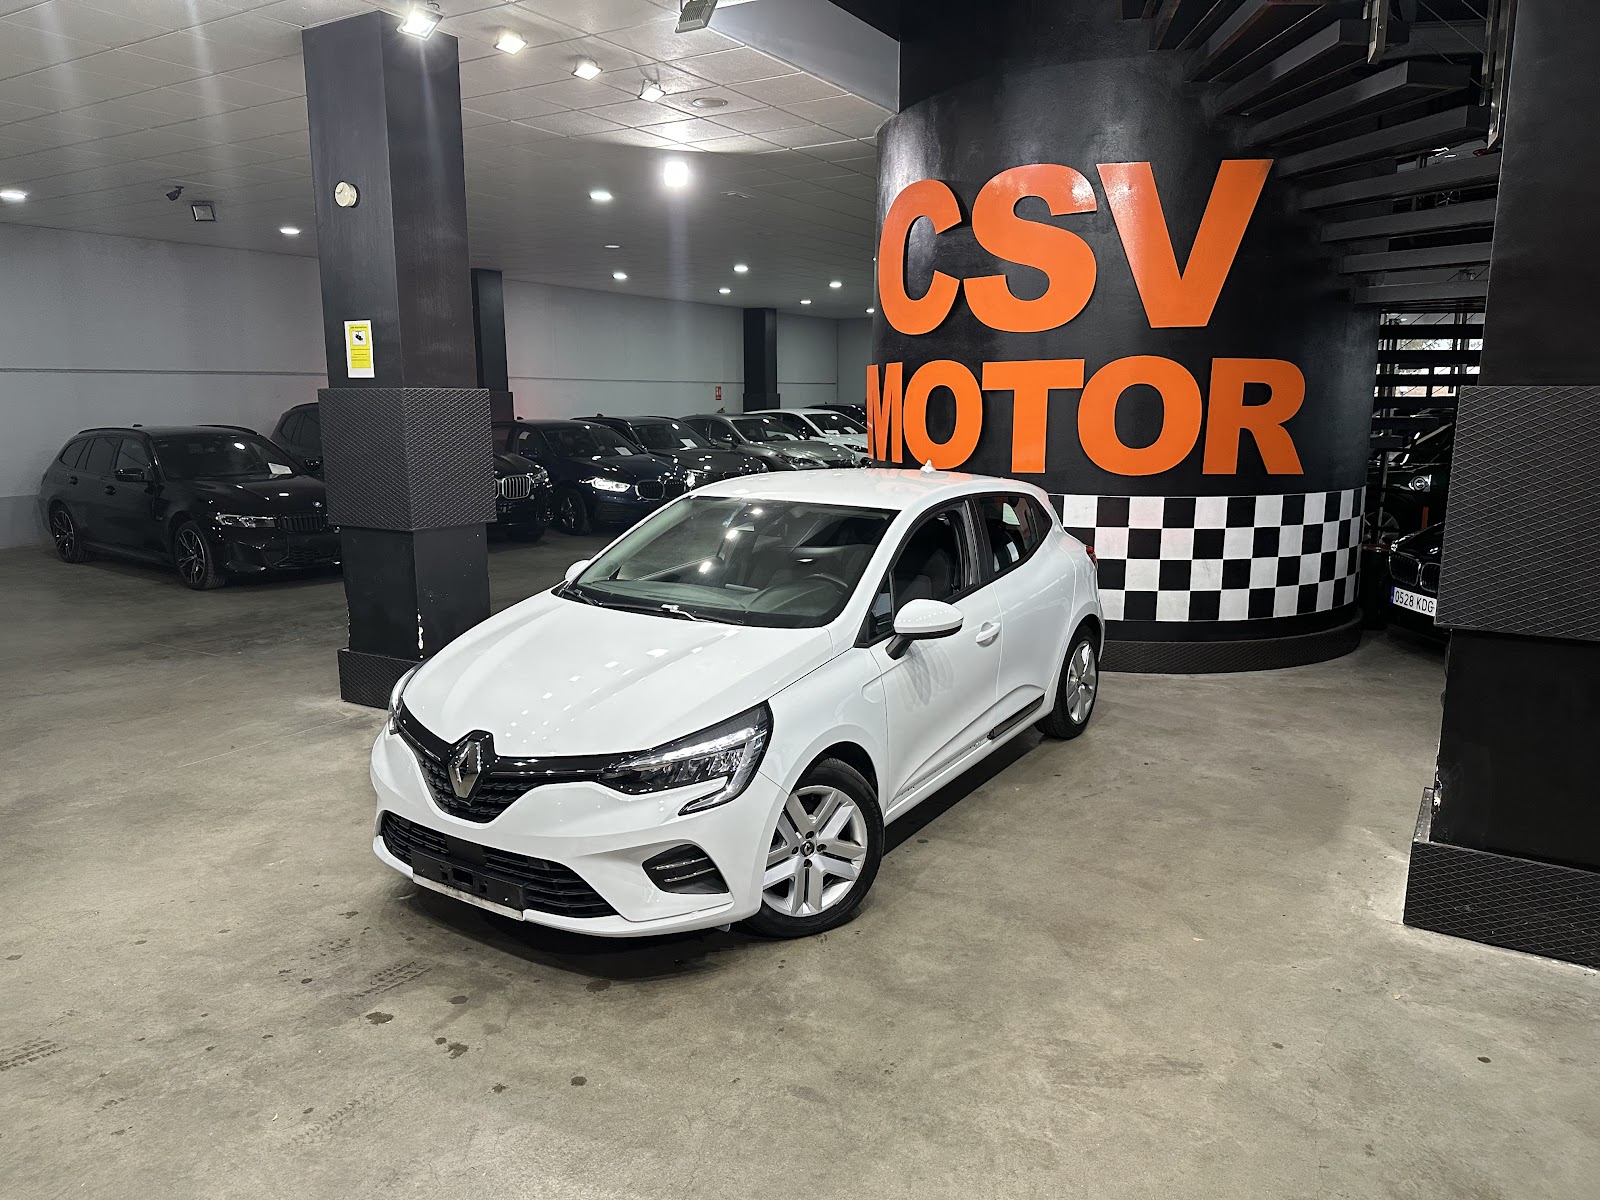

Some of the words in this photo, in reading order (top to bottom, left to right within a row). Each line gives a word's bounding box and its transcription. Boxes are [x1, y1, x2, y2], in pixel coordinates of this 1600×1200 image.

[878, 159, 1274, 336] CSV
[866, 355, 1306, 476] MOTOR
[1395, 590, 1414, 608] 0528
[1416, 597, 1435, 613] KDG
